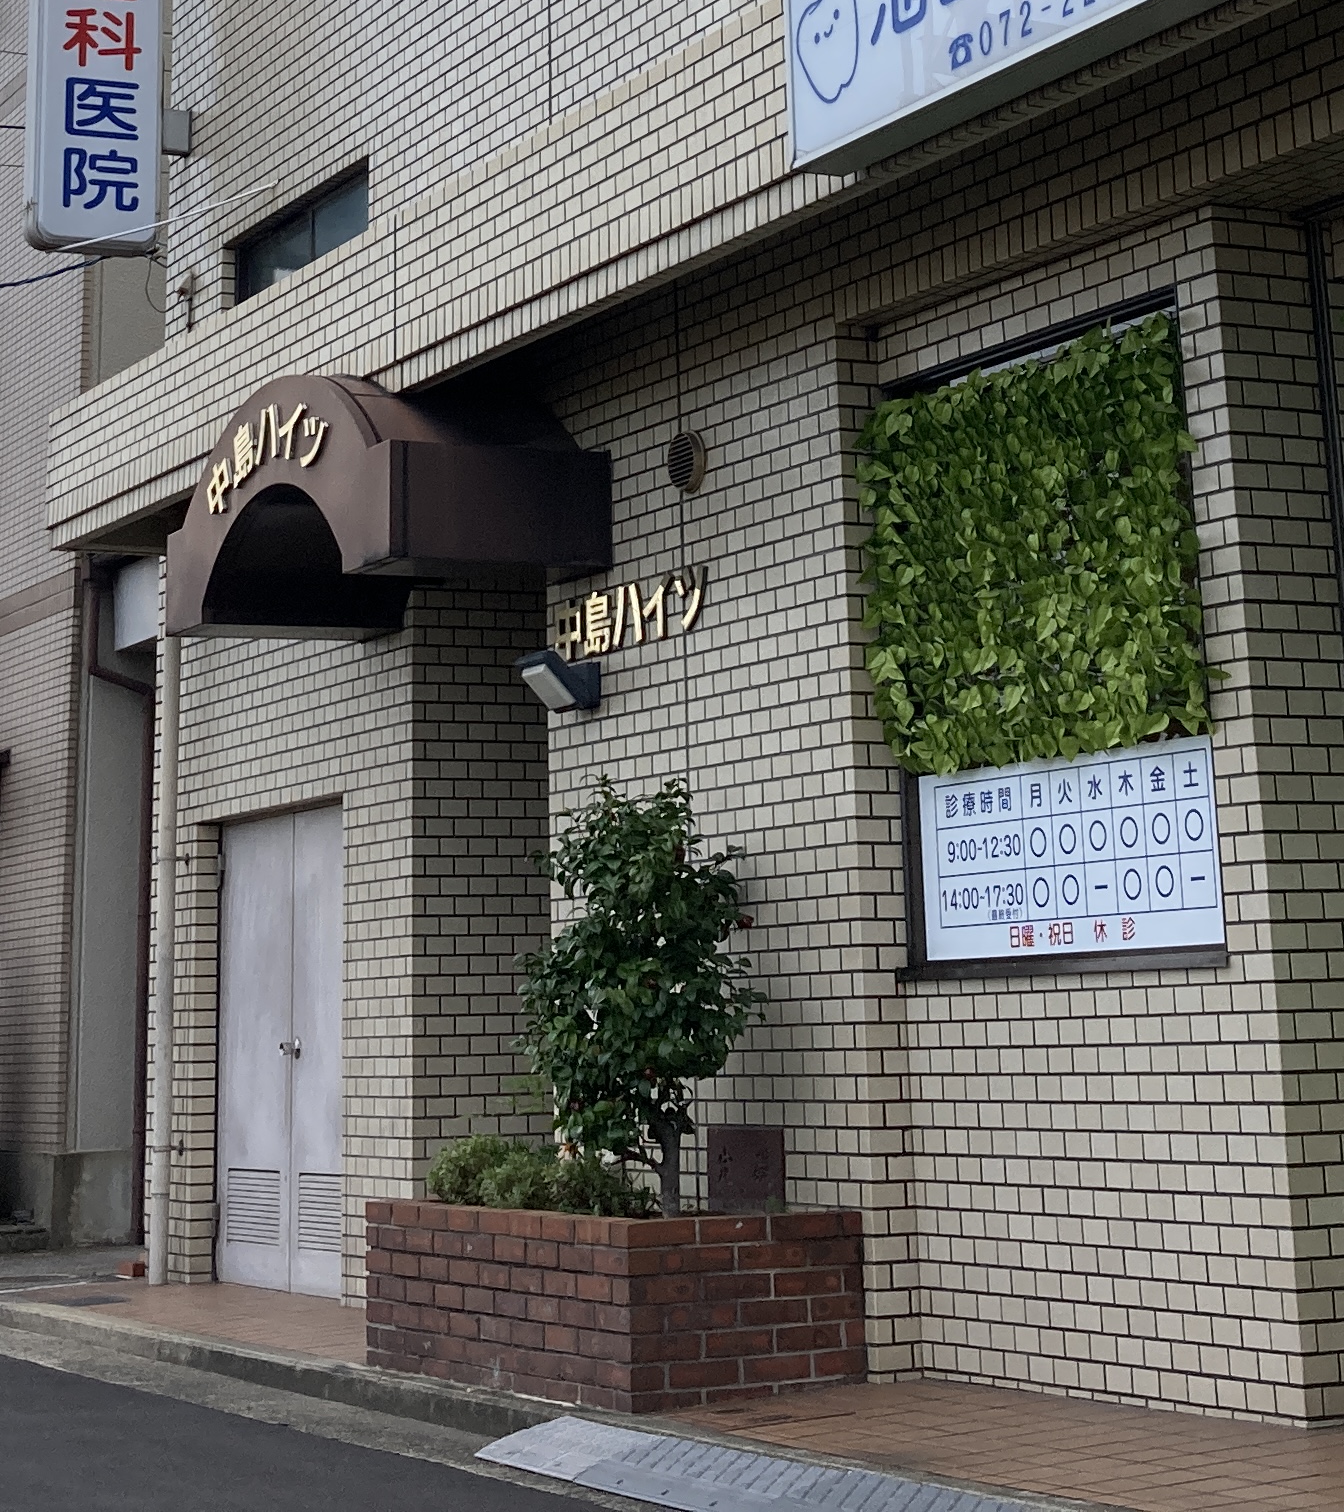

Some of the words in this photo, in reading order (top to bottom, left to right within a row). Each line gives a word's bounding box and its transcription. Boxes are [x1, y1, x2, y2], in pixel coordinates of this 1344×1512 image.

[206, 401, 330, 515] 中島ハイツ
[555, 565, 709, 662] 中島ハイツ
[945, 787, 1012, 819] 診療時間
[1029, 783, 1043, 809] 月
[1058, 778, 1074, 805] 火
[1087, 774, 1103, 800] 水
[1118, 769, 1135, 797] 木
[1149, 765, 1167, 793] 金
[1183, 761, 1200, 789] 土
